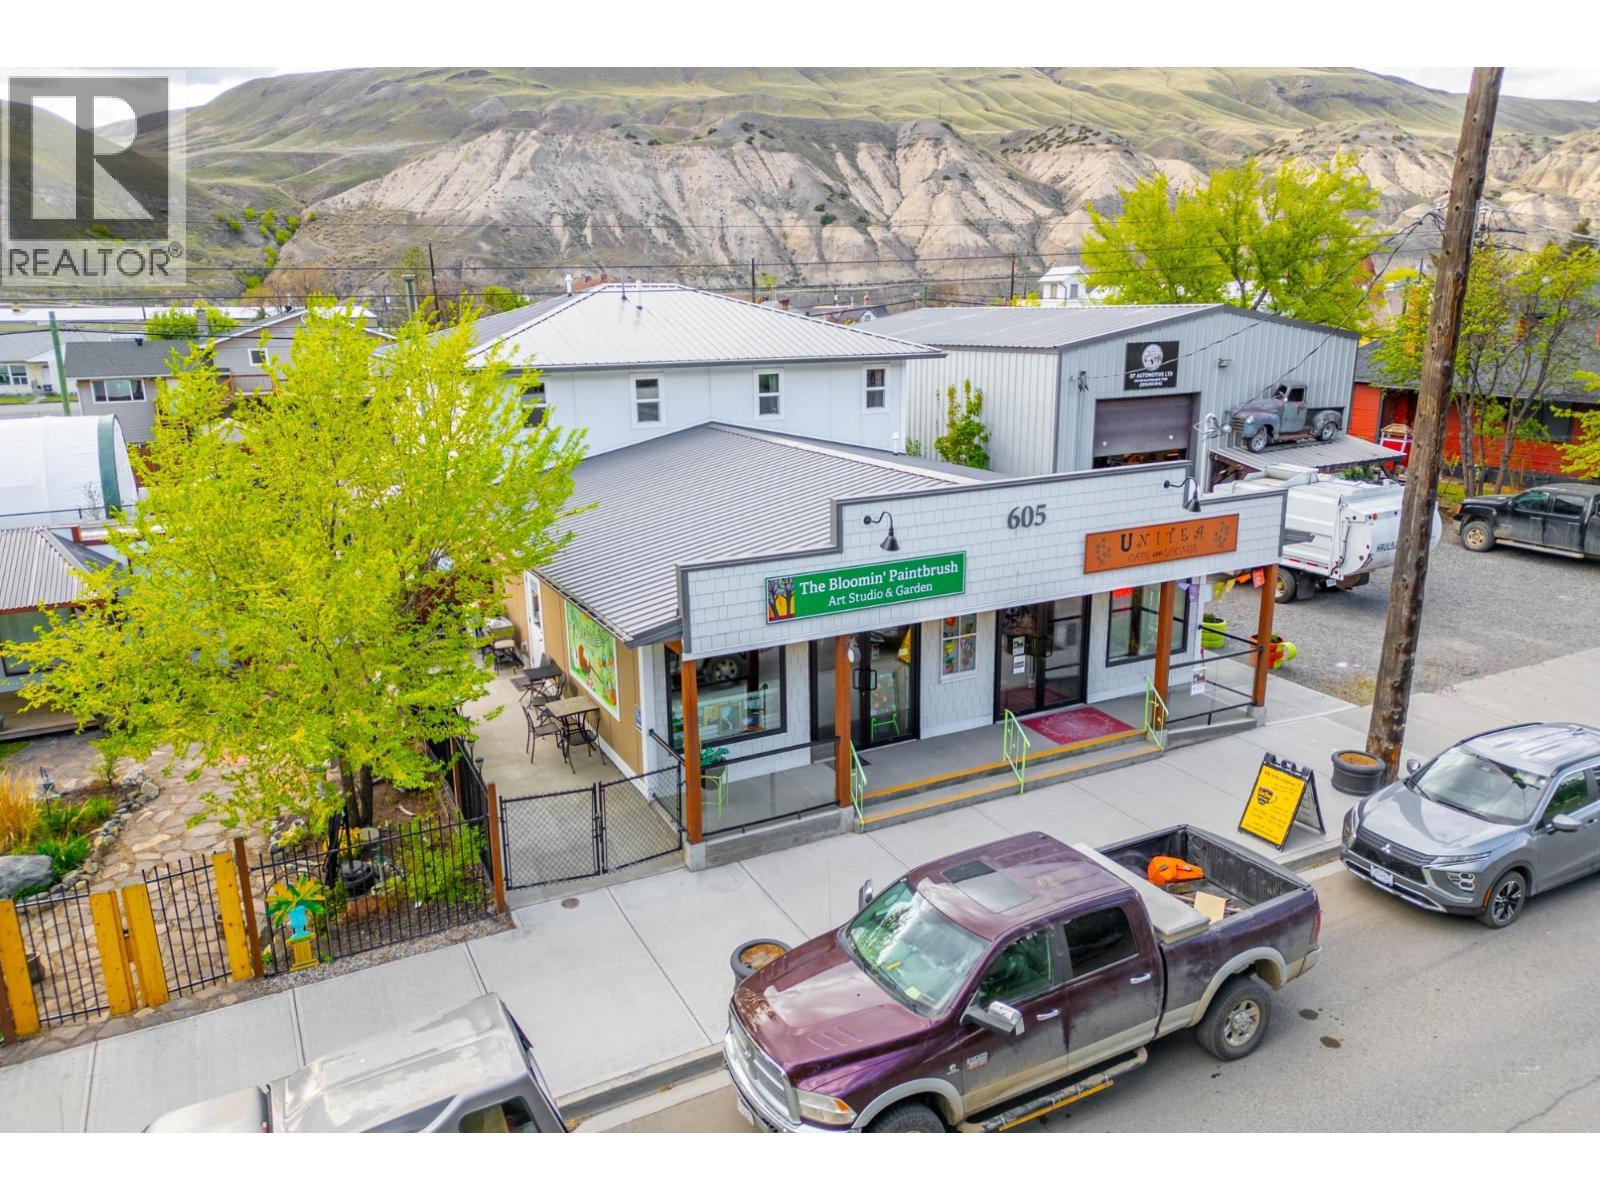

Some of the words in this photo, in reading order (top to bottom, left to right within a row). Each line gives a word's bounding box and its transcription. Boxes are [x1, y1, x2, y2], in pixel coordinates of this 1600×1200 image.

[1007, 504, 1047, 530] 605
[1120, 525, 1205, 552] UNITEA
[800, 581, 825, 595] The
[829, 571, 886, 591] Bloomin'
[889, 560, 959, 582] Paintbrush
[828, 595, 846, 606] Art
[848, 590, 884, 604] Studio
[885, 587, 893, 597] &
[895, 582, 933, 596] Garden
